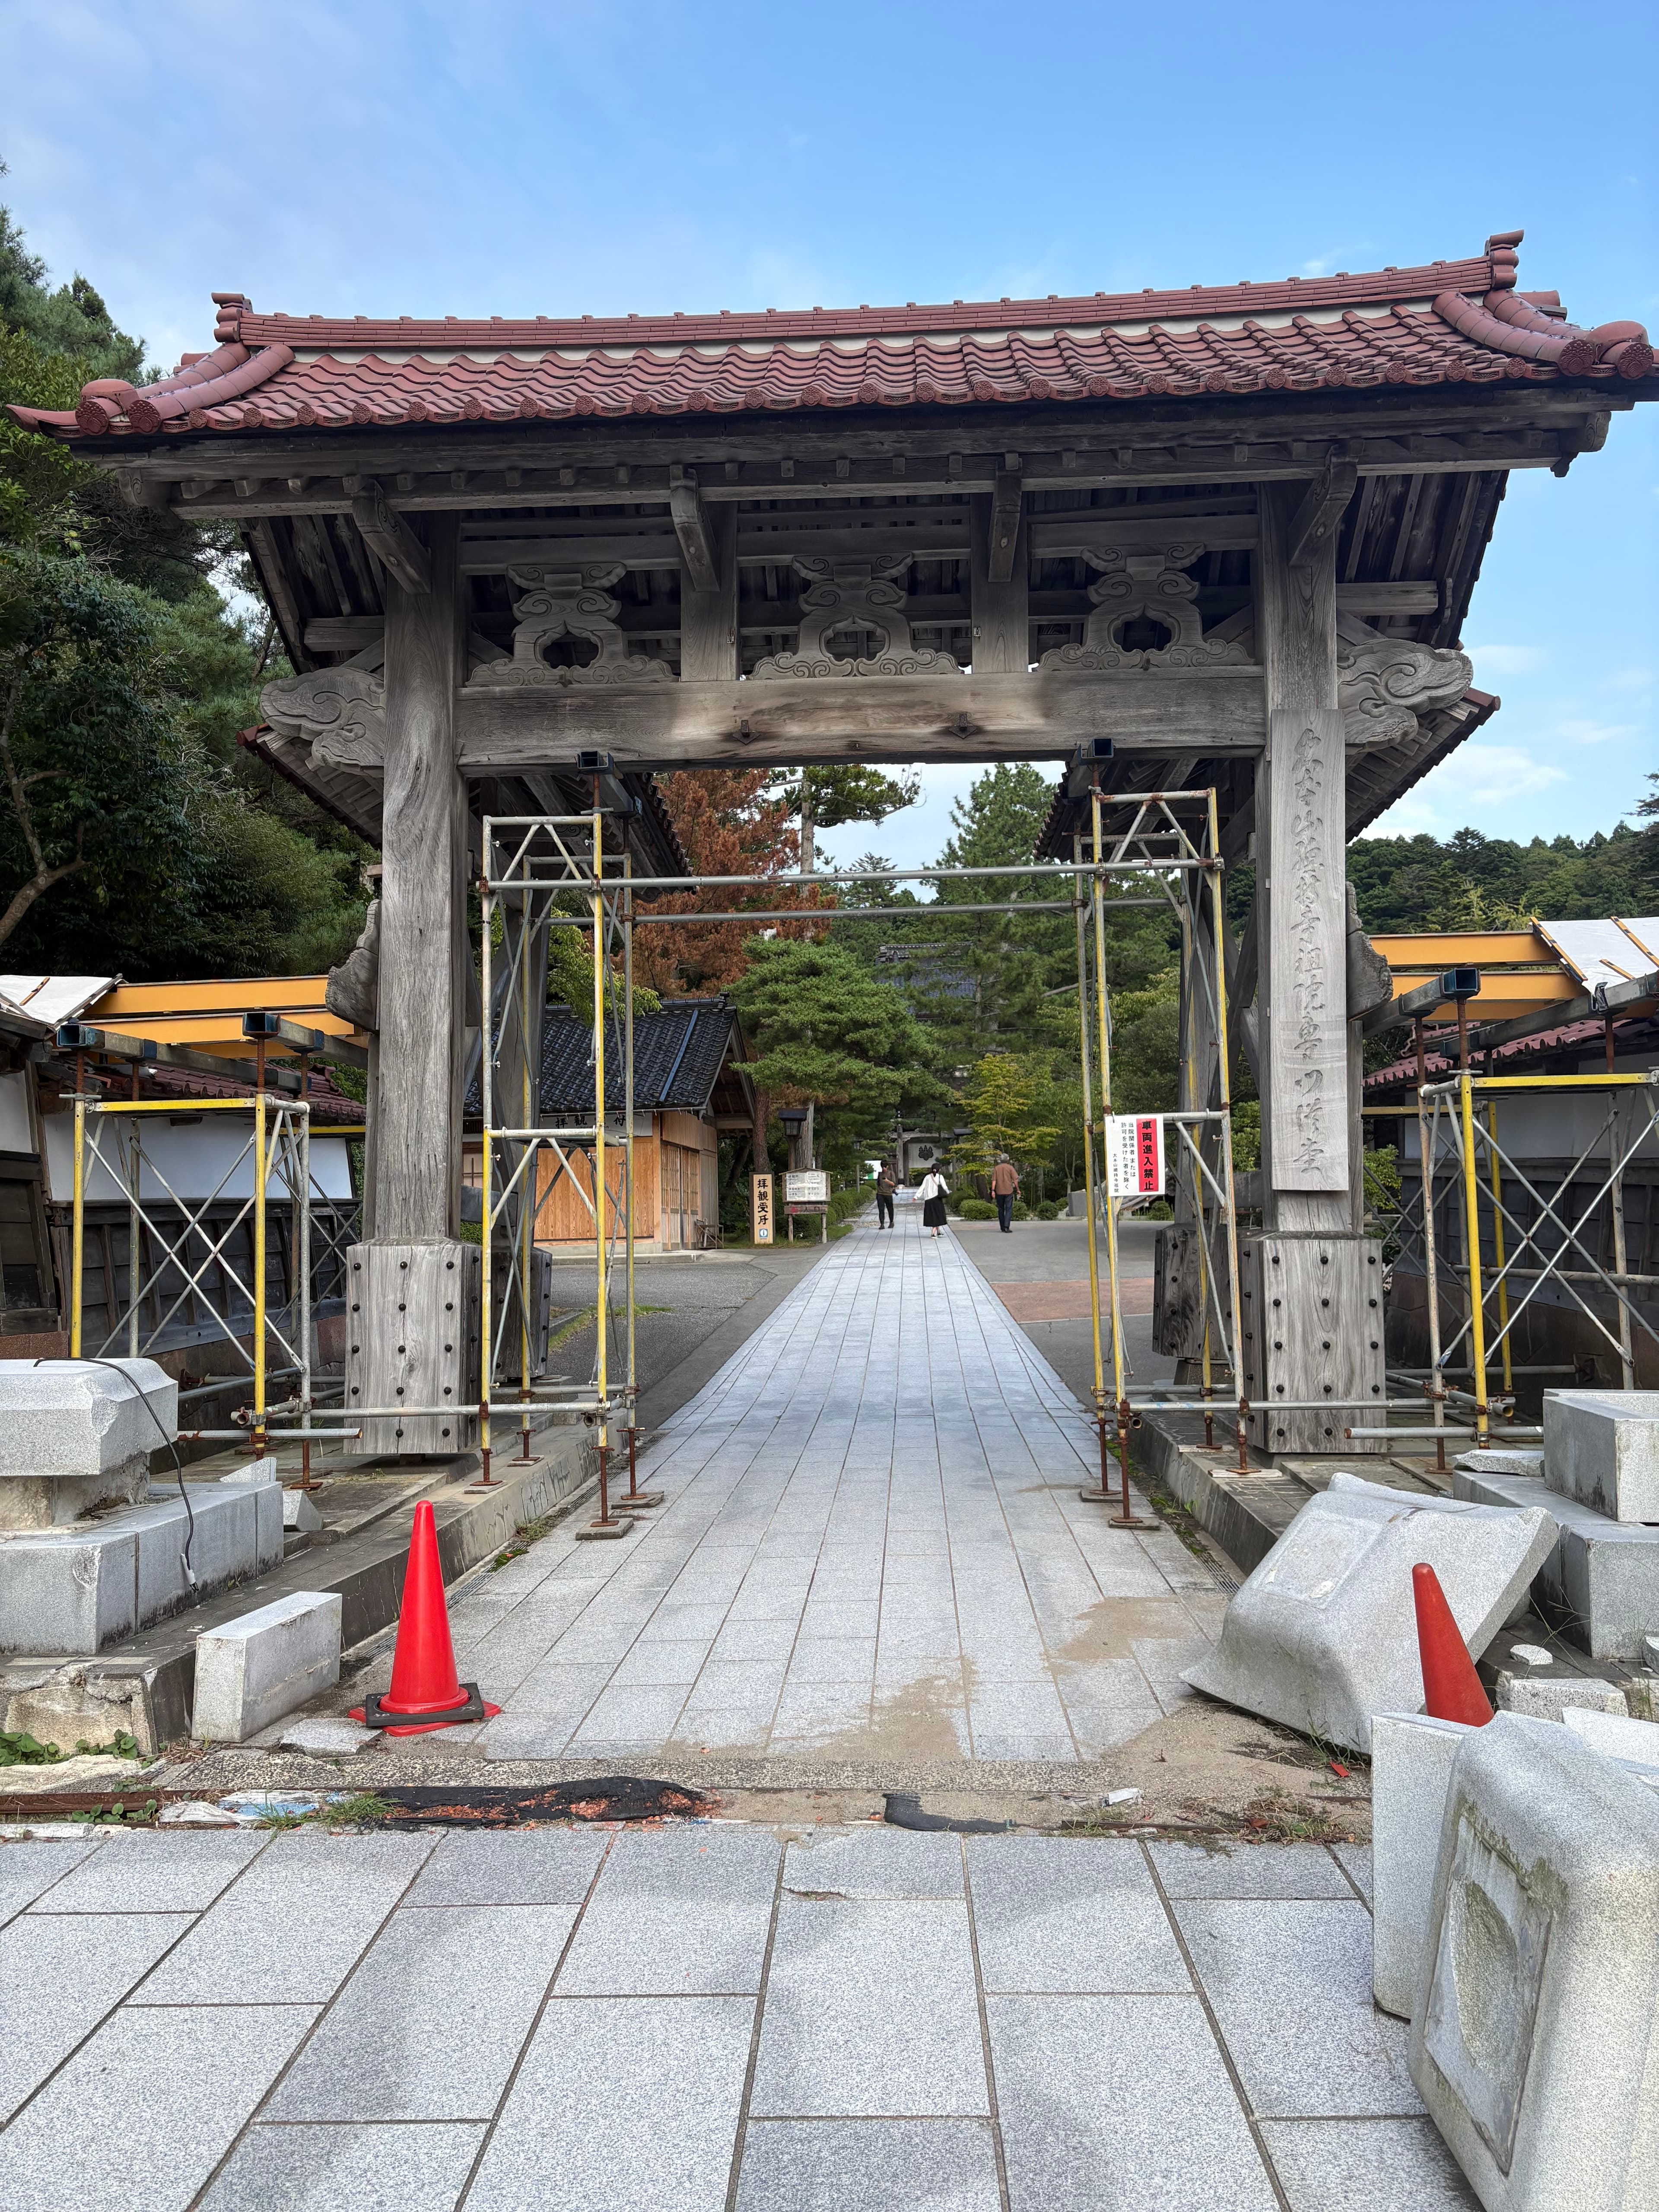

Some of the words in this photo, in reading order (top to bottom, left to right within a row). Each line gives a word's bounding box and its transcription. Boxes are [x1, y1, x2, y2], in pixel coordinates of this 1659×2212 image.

[555, 1115, 626, 1128] 拝観付
[1121, 1122, 1129, 1189] 許可を受けた者を除く
[1142, 1121, 1154, 1190] 車両進入禁止
[757, 1179, 769, 1225] 拝観受付
